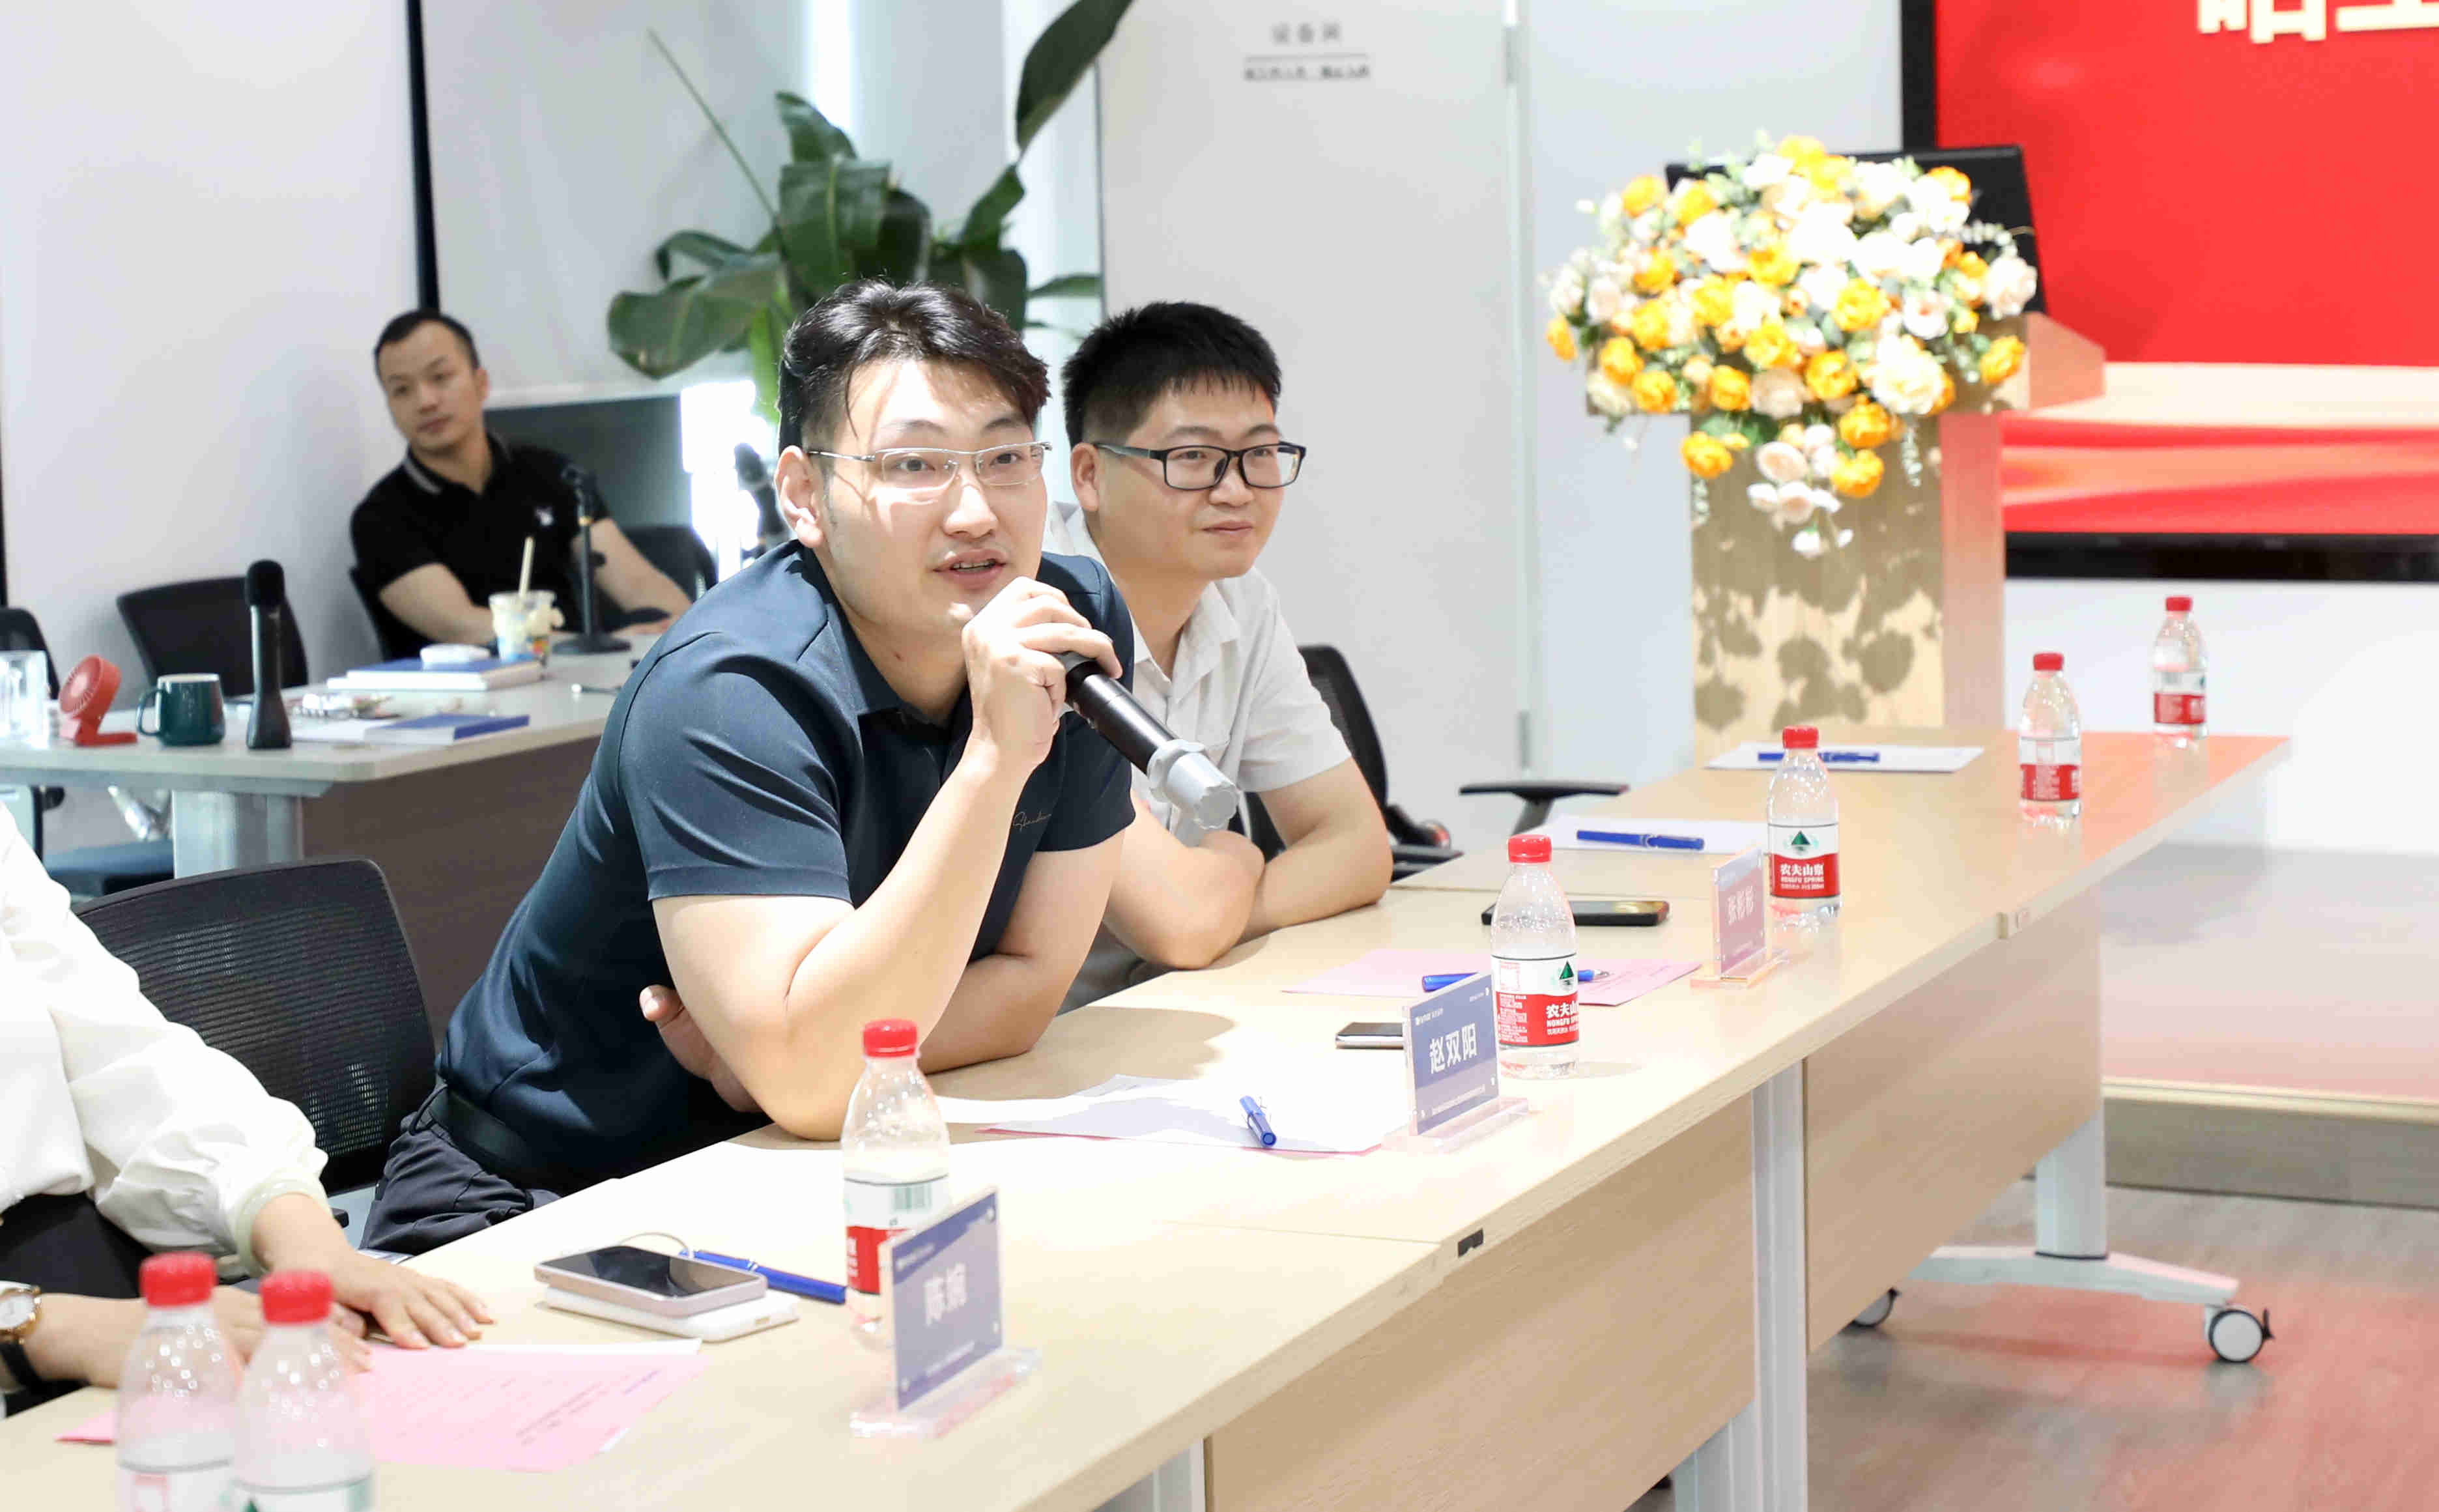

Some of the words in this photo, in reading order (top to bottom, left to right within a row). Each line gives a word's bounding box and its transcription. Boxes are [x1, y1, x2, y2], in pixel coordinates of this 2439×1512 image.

[1780, 864, 1824, 876] 农夫山泉
[1429, 1023, 1477, 1074] 赵双阳
